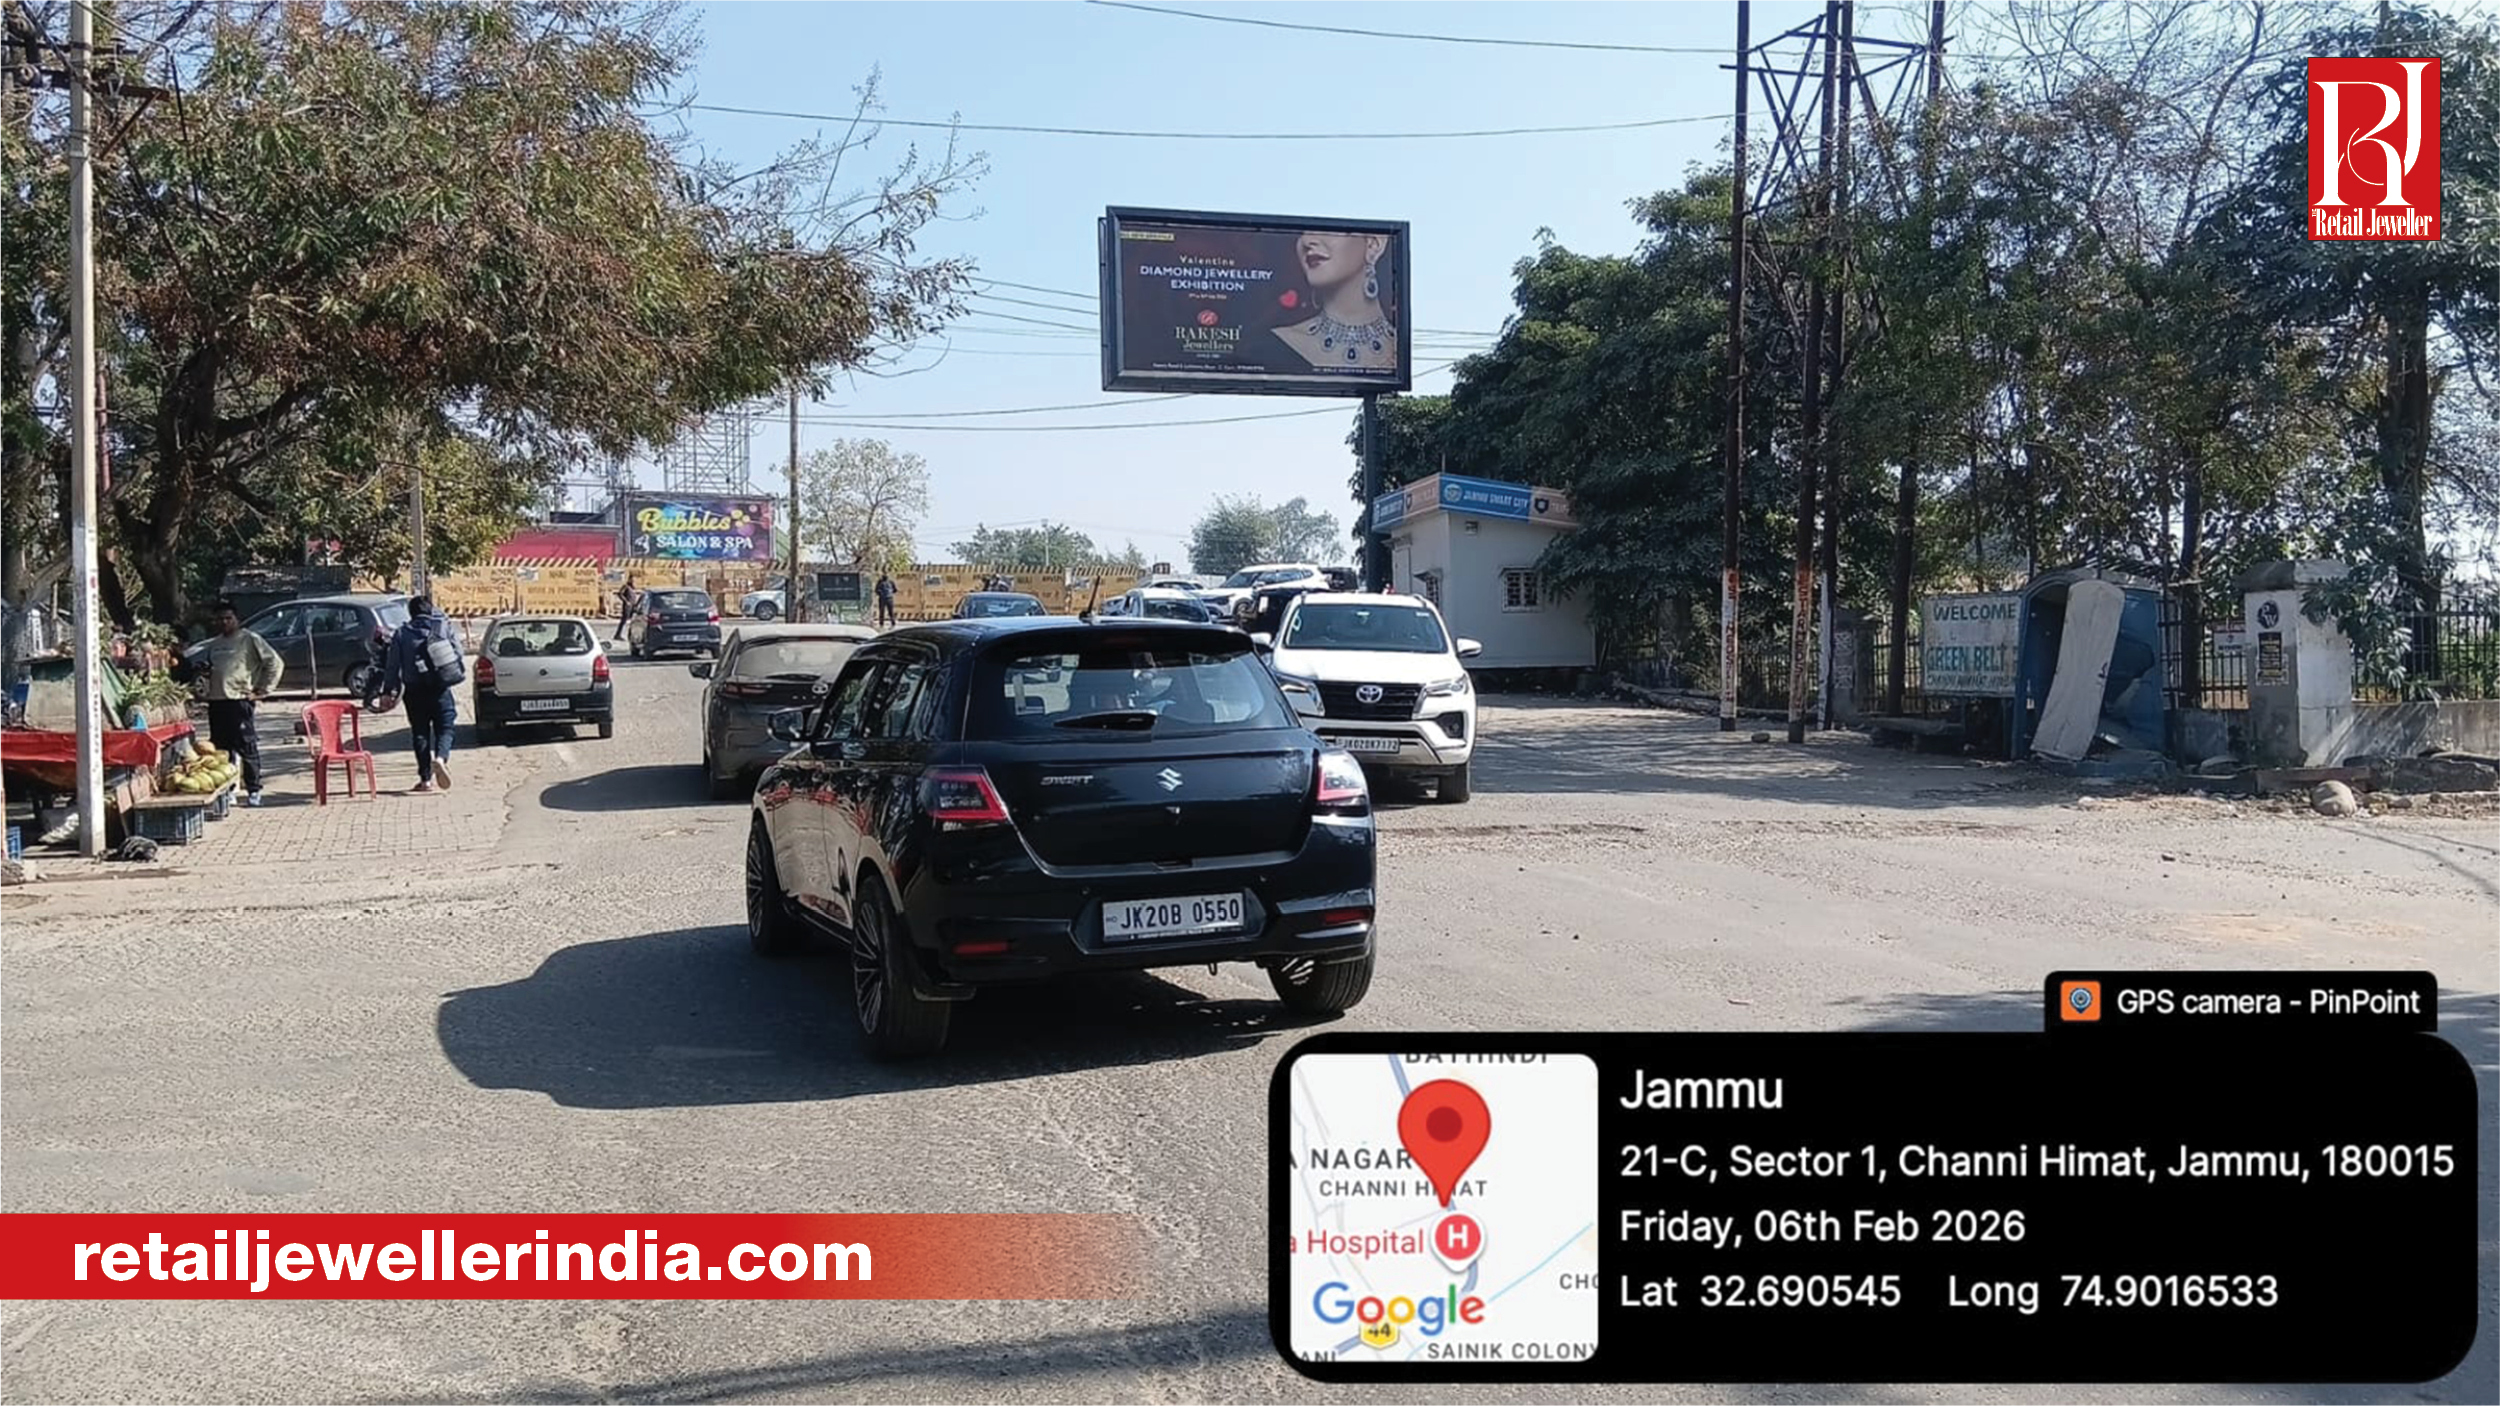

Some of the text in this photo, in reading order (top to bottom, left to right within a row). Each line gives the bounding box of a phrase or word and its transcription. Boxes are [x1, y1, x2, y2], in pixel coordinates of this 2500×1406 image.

[1179, 254, 1236, 267] Valentine
[1140, 265, 1274, 281] DIAMOND JEWELLERY
[1170, 279, 1245, 292] EXHIBITION
[1175, 326, 1240, 340] RAKESH
[1183, 340, 1234, 351] Jewellers
[637, 507, 731, 532] Bubbles
[656, 535, 754, 550] SALON & SPA
[1933, 603, 2017, 621] WELCOME
[1926, 643, 2008, 672] GREEN BELT
[1121, 899, 1240, 929] JK20B 0550
